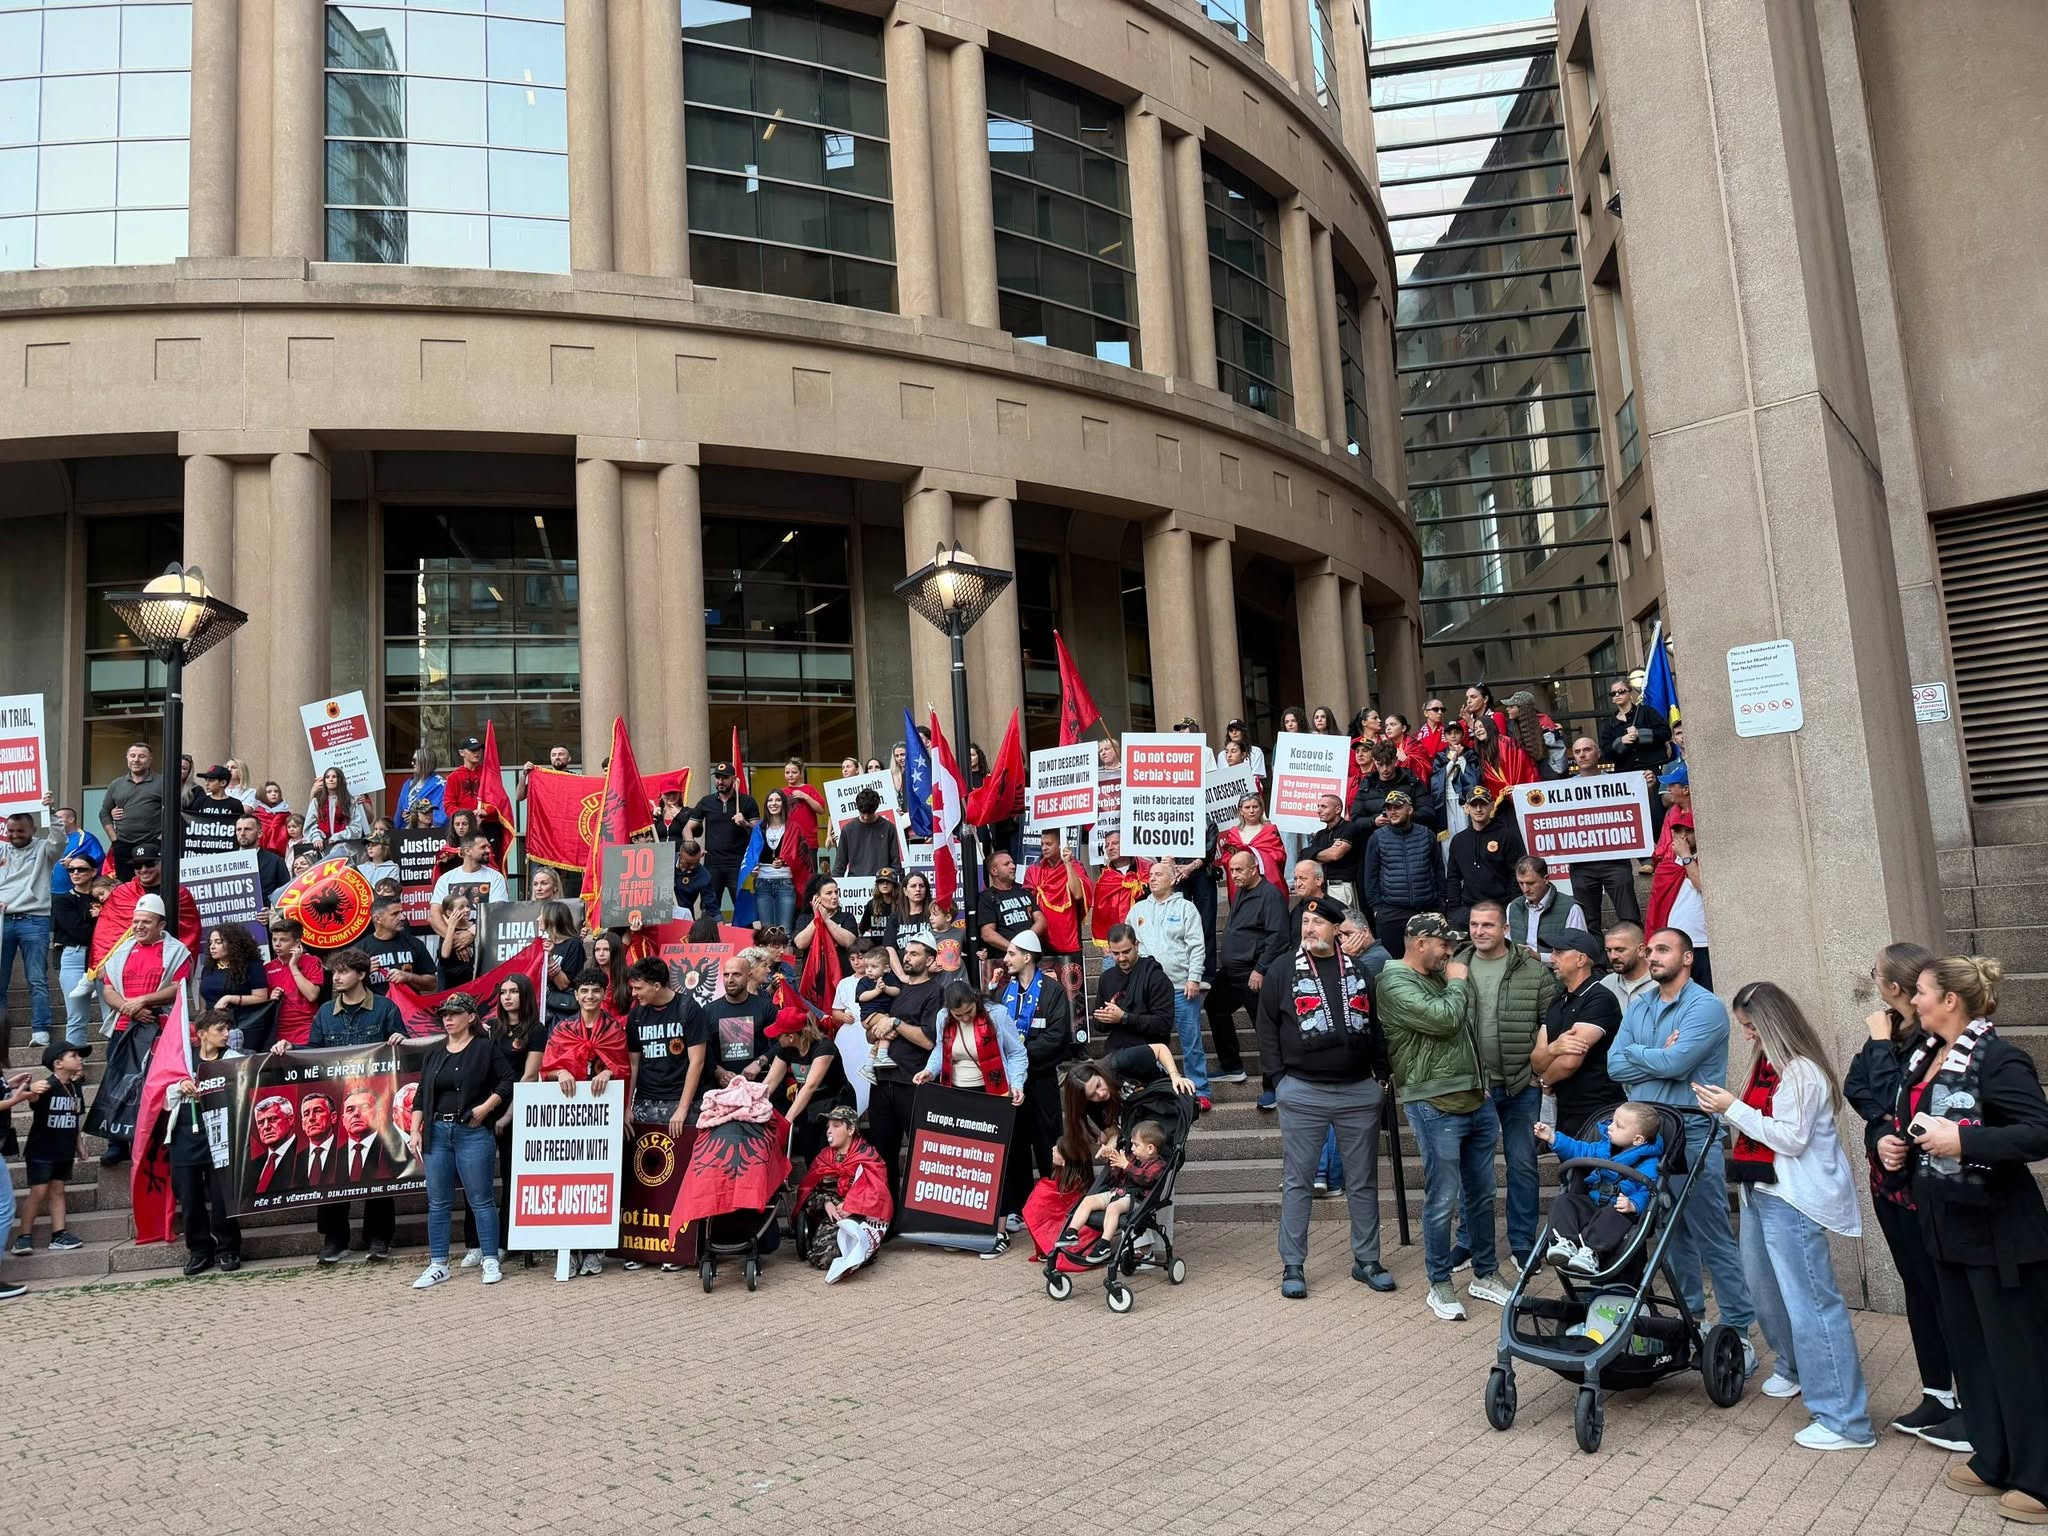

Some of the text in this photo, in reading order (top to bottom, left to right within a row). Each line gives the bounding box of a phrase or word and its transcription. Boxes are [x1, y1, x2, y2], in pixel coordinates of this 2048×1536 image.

[9, 707, 36, 728] TRIAL,
[1038, 754, 1090, 772] DO NOT DESECRATE
[1133, 750, 1194, 764] Do not cover
[1290, 748, 1334, 760] Kosovo is
[1133, 769, 1194, 784] Serbia's guilt
[1289, 762, 1334, 773] multiethnic.
[1038, 771, 1090, 789] OUR FREEDOM WITH
[1284, 780, 1336, 790] Why have you made
[837, 788, 844, 798] A
[1214, 778, 1249, 801] DESECRATE
[1282, 790, 1292, 798] the
[1294, 791, 1316, 800] Special
[1548, 782, 1636, 804] KLA ON TRIAL,
[1037, 798, 1058, 814] FALSE
[1059, 793, 1090, 811] JUSTICE!
[1133, 794, 1194, 805] with fabricated
[1280, 801, 1318, 810] mono-eth
[1133, 810, 1156, 822] files
[1159, 810, 1194, 824] against
[1532, 810, 1634, 830] SERBIAN CRIMINALS
[186, 820, 235, 837] Justice
[1133, 826, 1194, 846] Kosovo!
[185, 839, 234, 850] that convicts
[400, 836, 446, 854] Justice
[1535, 826, 1637, 852] ON VACATION!
[401, 856, 416, 867] that
[620, 848, 654, 880] JO
[914, 854, 932, 862] IF THE
[181, 860, 252, 878] IF THE KLA IS A CRIME,
[214, 878, 254, 898] NATO'S
[843, 887, 868, 898] court
[246, 897, 256, 908] IS
[620, 889, 654, 908] TIM!
[1000, 898, 1022, 912] LIRIA
[498, 920, 536, 940] LIRIA
[397, 951, 414, 964] KA
[666, 1022, 684, 1038] KA
[284, 1060, 401, 1081] JO NË EMRIN TIM!
[47, 1112, 76, 1128] EMËR
[526, 1104, 610, 1128] DO NOT DESECRATE
[926, 1111, 999, 1134] Europe, remember:
[524, 1138, 608, 1162] OUR FREEDOM WITH
[640, 1134, 672, 1150] UÇK
[922, 1140, 994, 1164] you were with us
[920, 1160, 992, 1184] against Serbian
[254, 1198, 269, 1208] PËR
[272, 1196, 282, 1204] TË
[286, 1192, 324, 1203] VËRTETËN,
[328, 1188, 368, 1198] DINJITETIN
[371, 1186, 384, 1194] DHE
[521, 1184, 608, 1216] FALSE JUSTICE!
[914, 1180, 990, 1210] genocide!
[621, 1208, 660, 1227] ot in
[622, 1234, 676, 1253] name!
